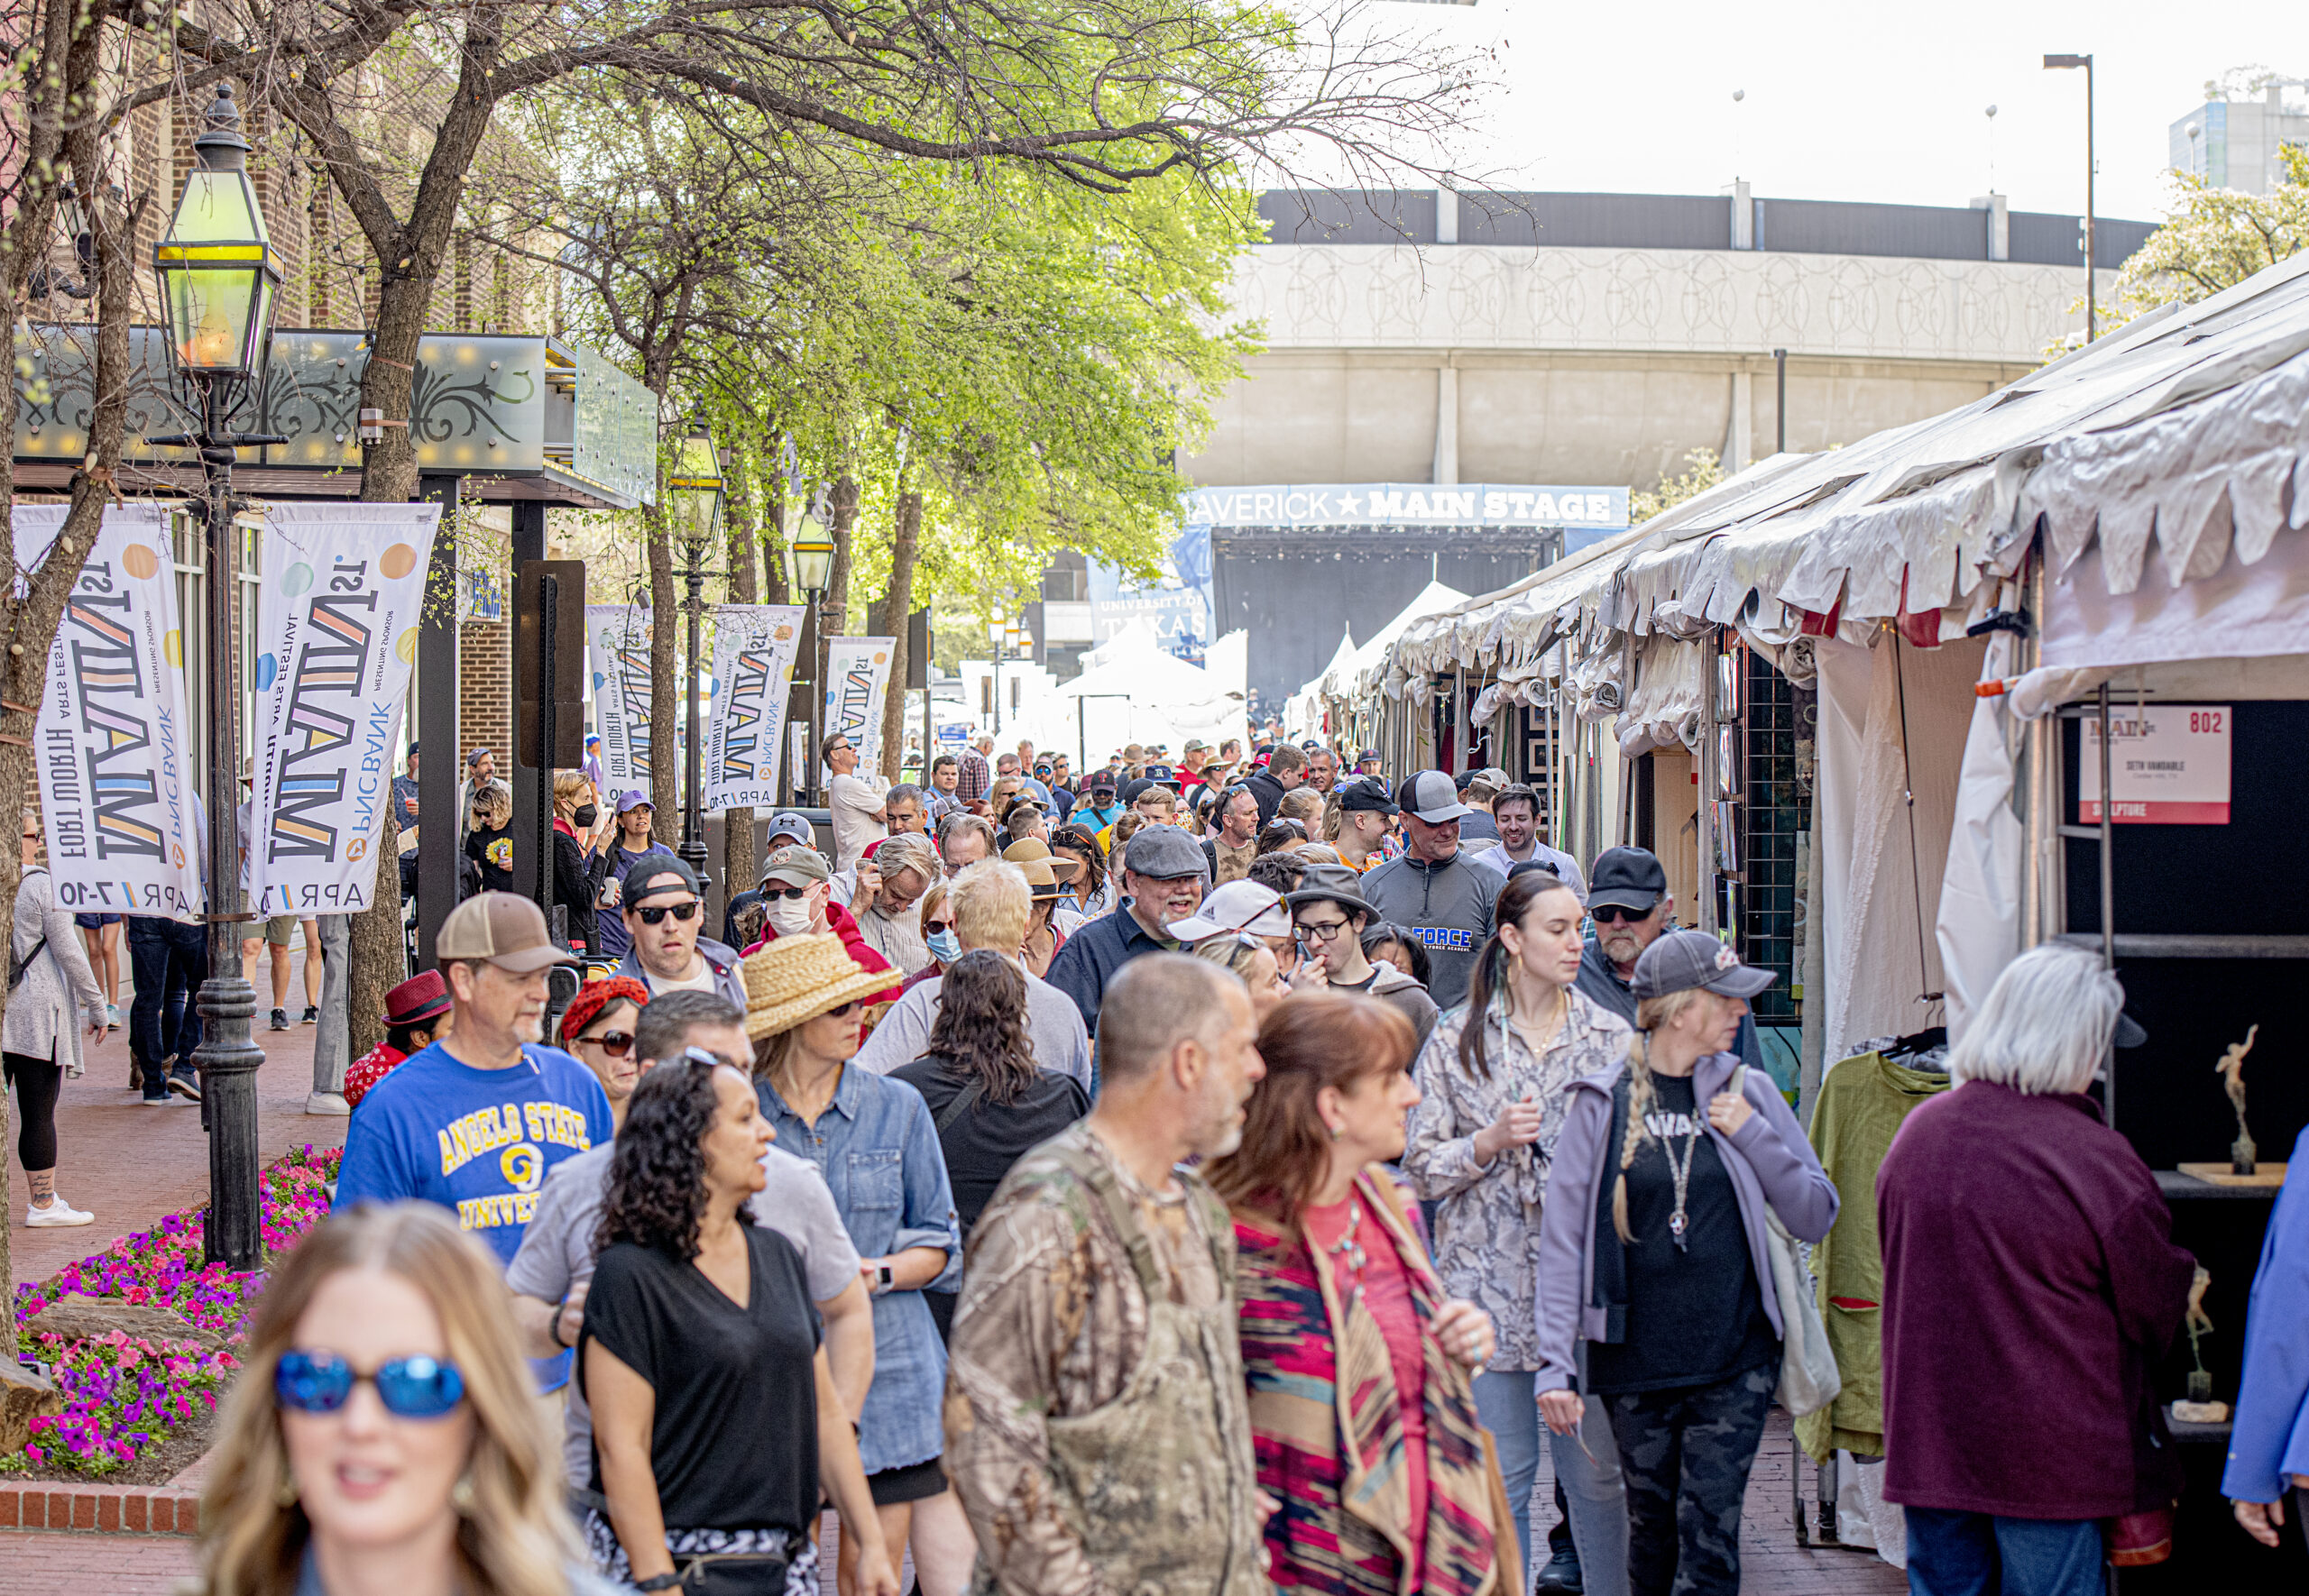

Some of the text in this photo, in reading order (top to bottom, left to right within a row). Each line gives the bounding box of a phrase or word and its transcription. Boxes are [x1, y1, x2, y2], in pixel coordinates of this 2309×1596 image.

[1368, 491, 1476, 518] MAIN
[1484, 491, 1611, 520] STAGE
[1100, 596, 1182, 611] UNIVERSITY
[2190, 711, 2222, 734] 802
[1412, 927, 1472, 947] FORCE
[437, 1101, 591, 1177] ANGELO STATE
